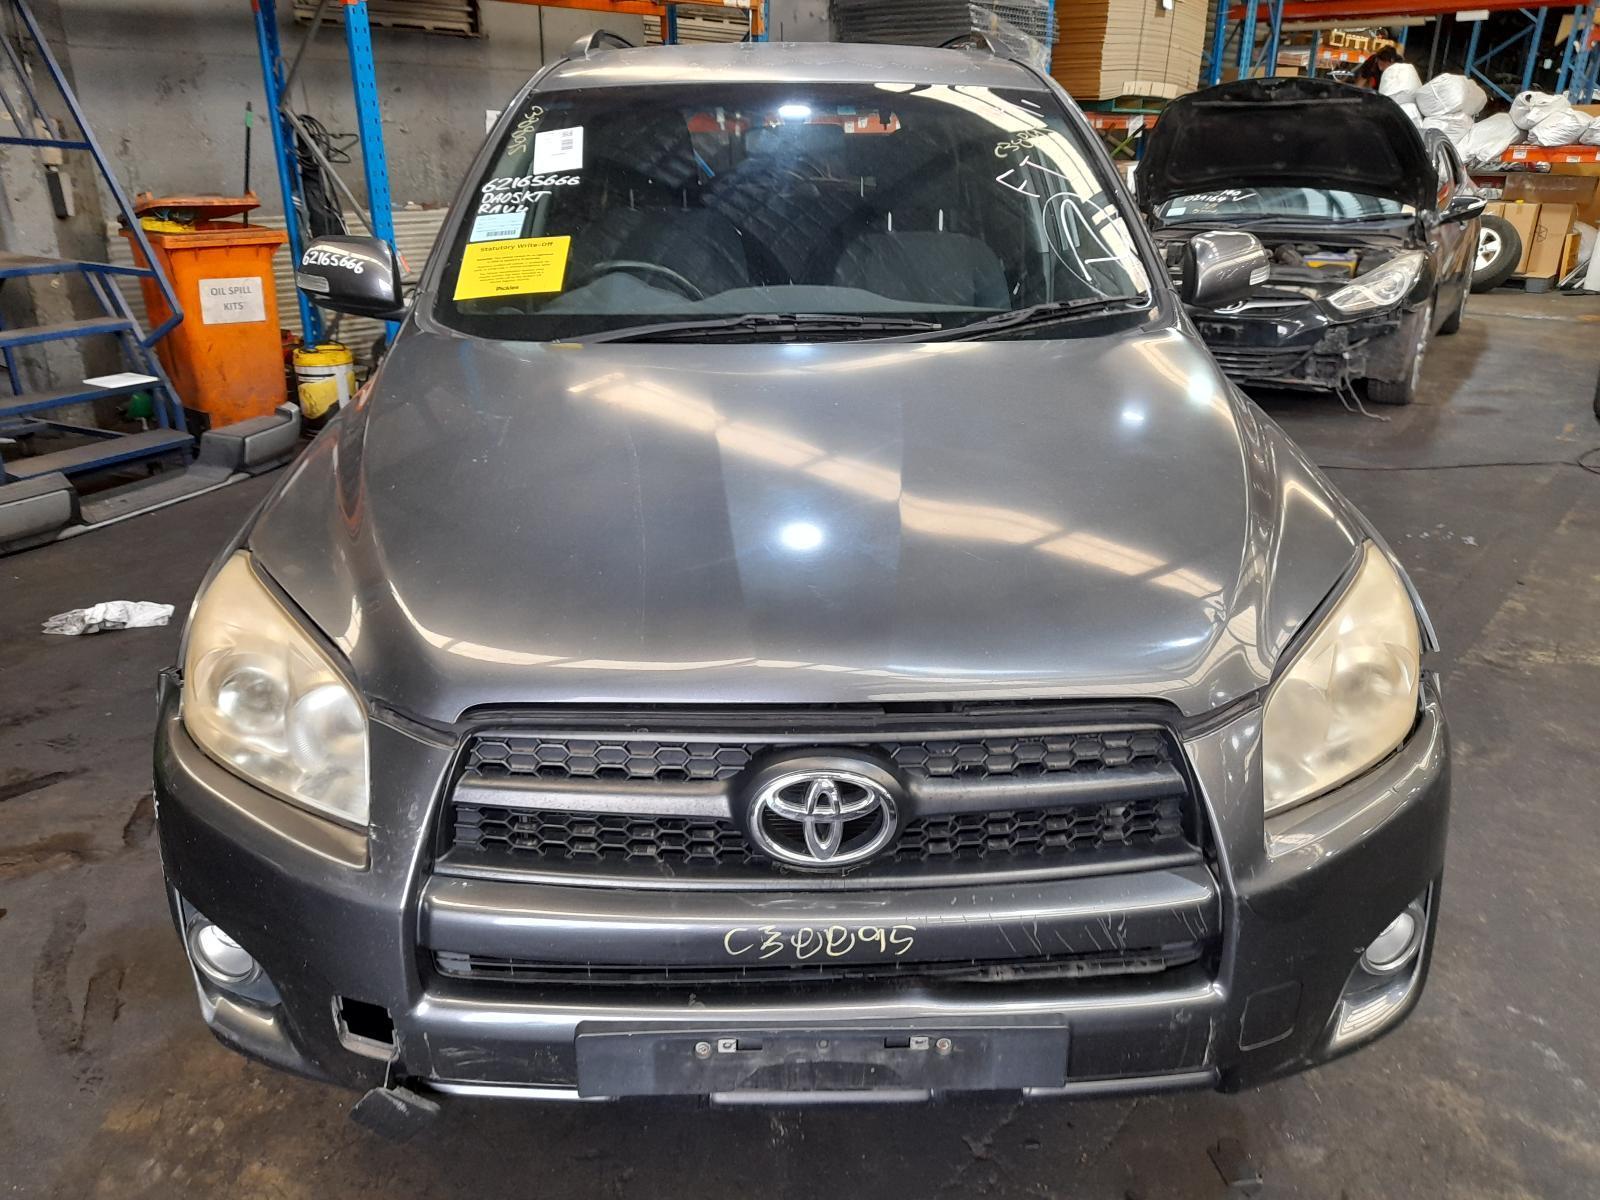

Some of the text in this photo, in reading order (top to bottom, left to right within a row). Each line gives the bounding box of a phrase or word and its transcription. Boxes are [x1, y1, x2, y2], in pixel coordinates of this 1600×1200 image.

[481, 174, 581, 193] 62165666
[517, 241, 554, 249] Write-Off
[302, 251, 364, 274] 62165666
[210, 283, 252, 296] OIL SPILL
[223, 302, 244, 311] KITS
